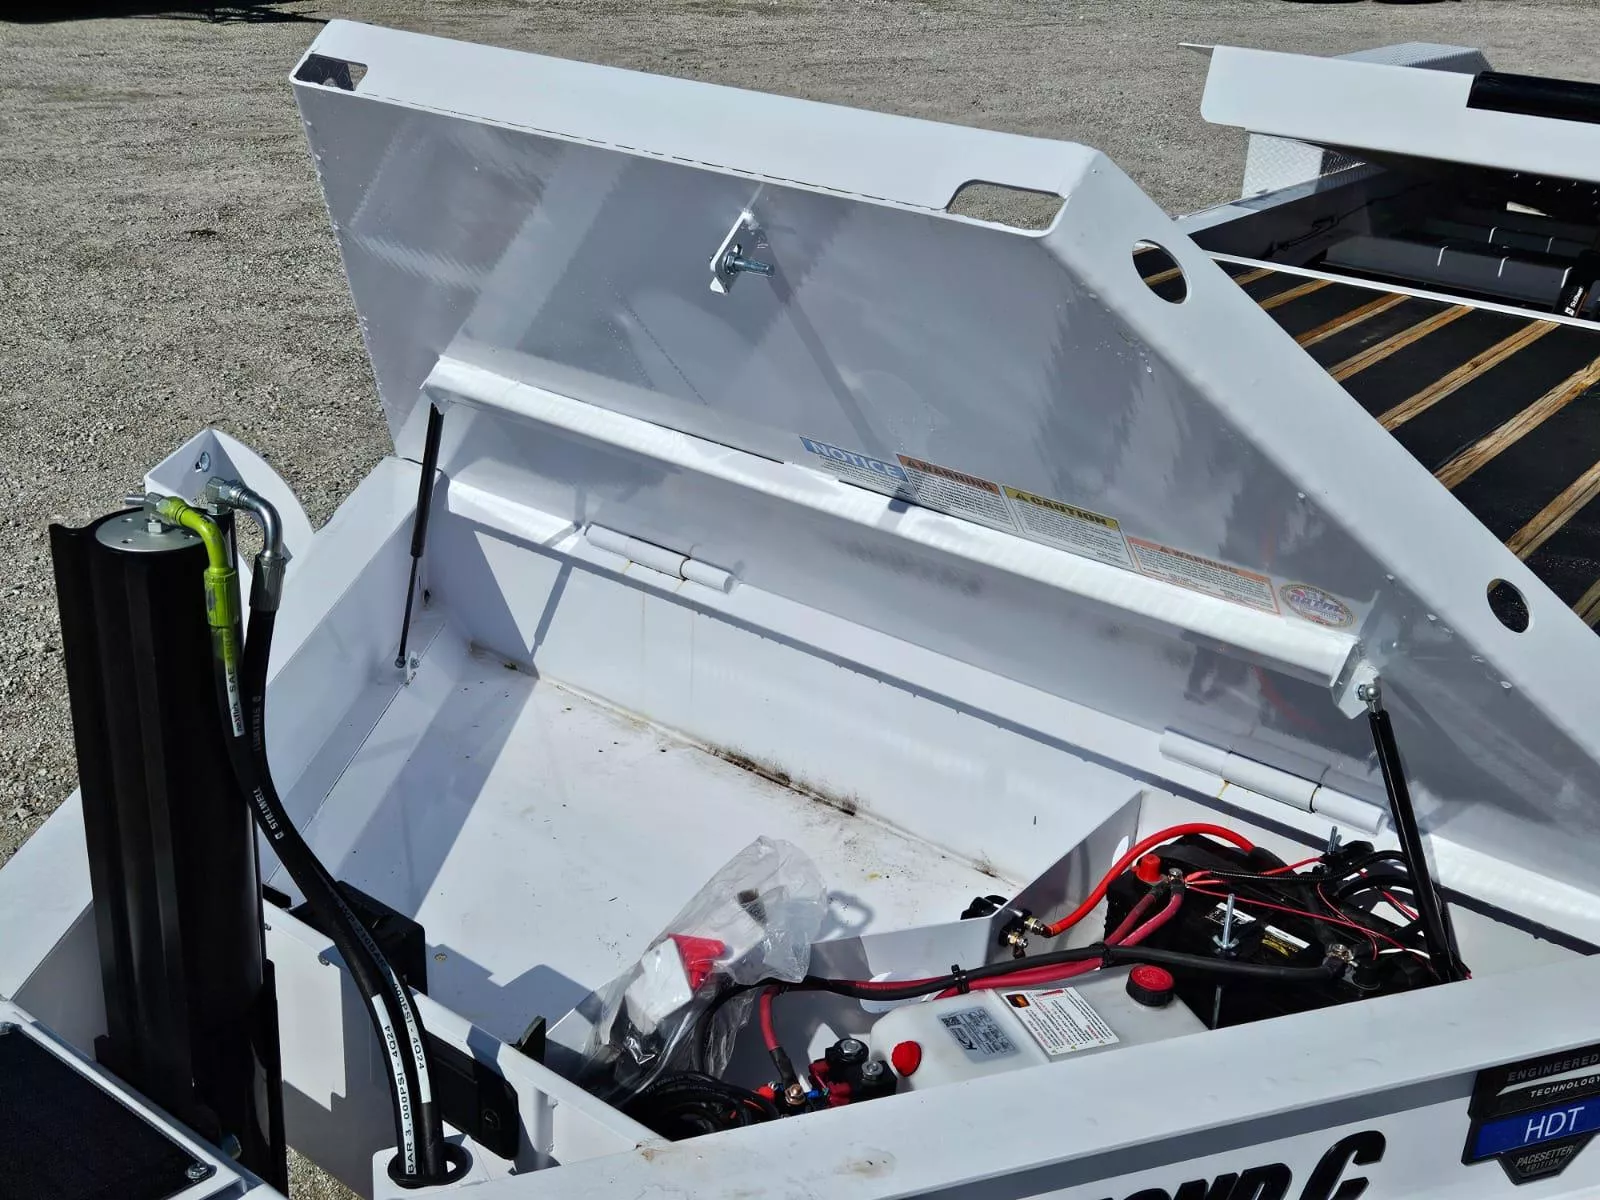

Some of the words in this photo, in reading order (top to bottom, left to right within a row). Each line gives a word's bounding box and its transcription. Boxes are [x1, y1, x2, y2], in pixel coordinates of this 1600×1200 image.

[809, 439, 900, 478] NOTICE
[1030, 496, 1107, 525] CAUTION
[228, 667, 236, 693] SAE
[253, 786, 279, 830] STILLWELL
[384, 1025, 398, 1058] 4Q24
[412, 1036, 425, 1070] 4Q24
[1507, 1053, 1600, 1081] ENGINEERED
[1524, 1106, 1585, 1143] HDT
[407, 1142, 416, 1174] BAR
[1515, 1145, 1576, 1167] PACESETTER
